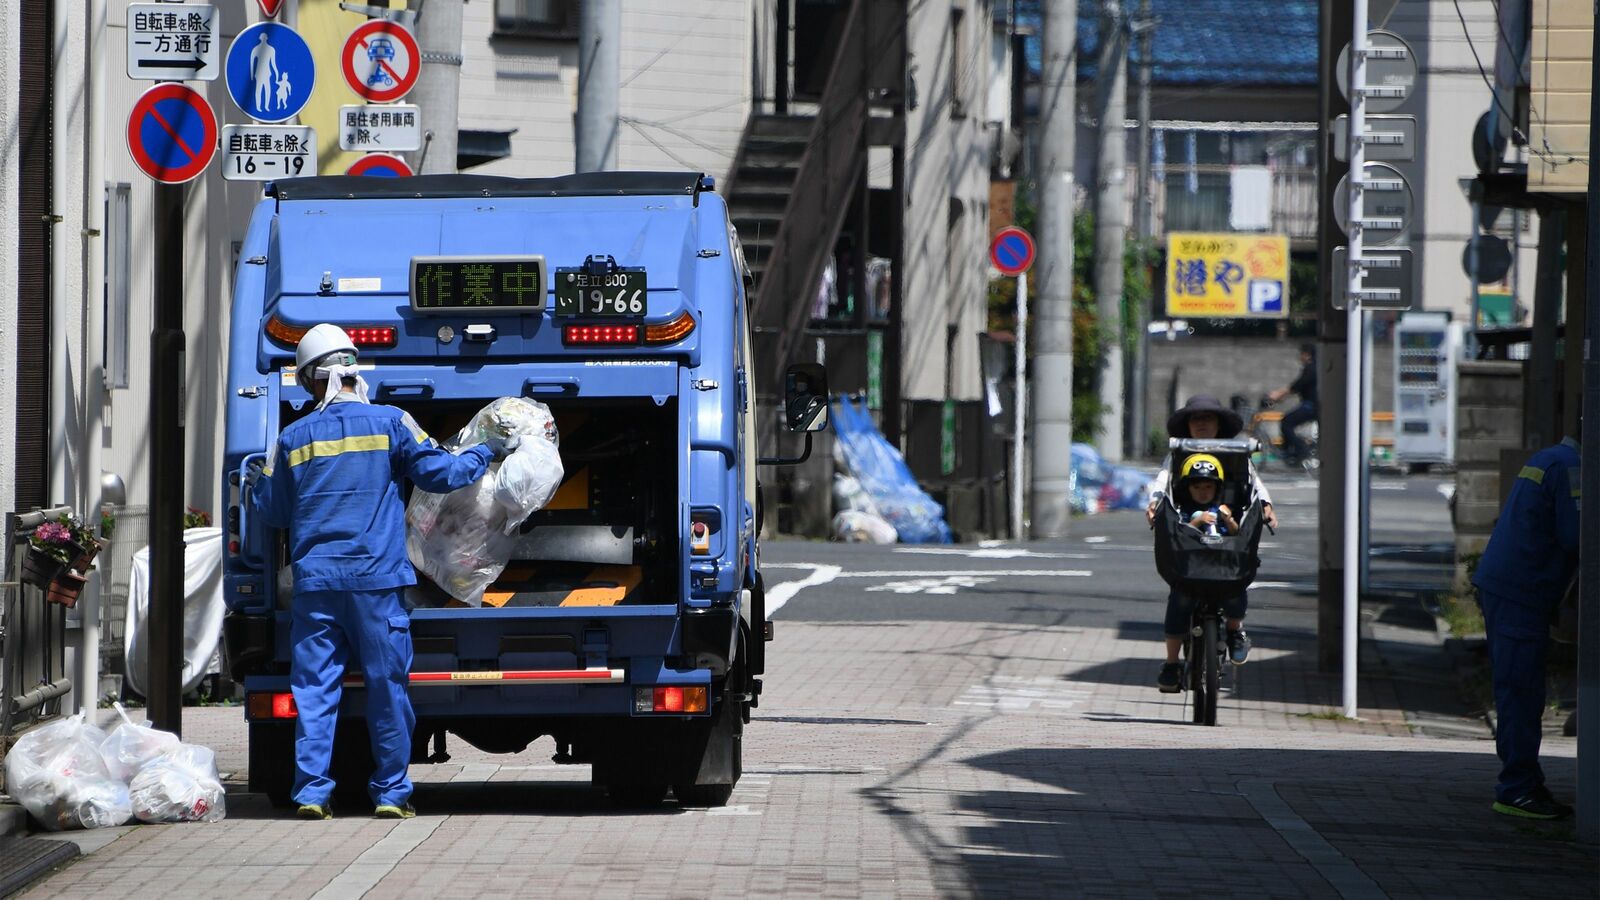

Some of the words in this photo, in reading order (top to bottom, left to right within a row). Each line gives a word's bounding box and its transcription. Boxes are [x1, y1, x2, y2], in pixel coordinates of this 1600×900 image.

[135, 12, 211, 31] 自転車を除く
[135, 34, 211, 53] 一方通行
[346, 112, 415, 127] 居住者用車両
[229, 133, 309, 152] 自転車を除く
[346, 129, 381, 144] を除く
[418, 264, 538, 305] 作業中
[605, 273, 628, 287] 800
[1174, 258, 1245, 296] 港や
[560, 296, 573, 307] い
[578, 289, 643, 314] 19-66
[1250, 280, 1281, 312] P
